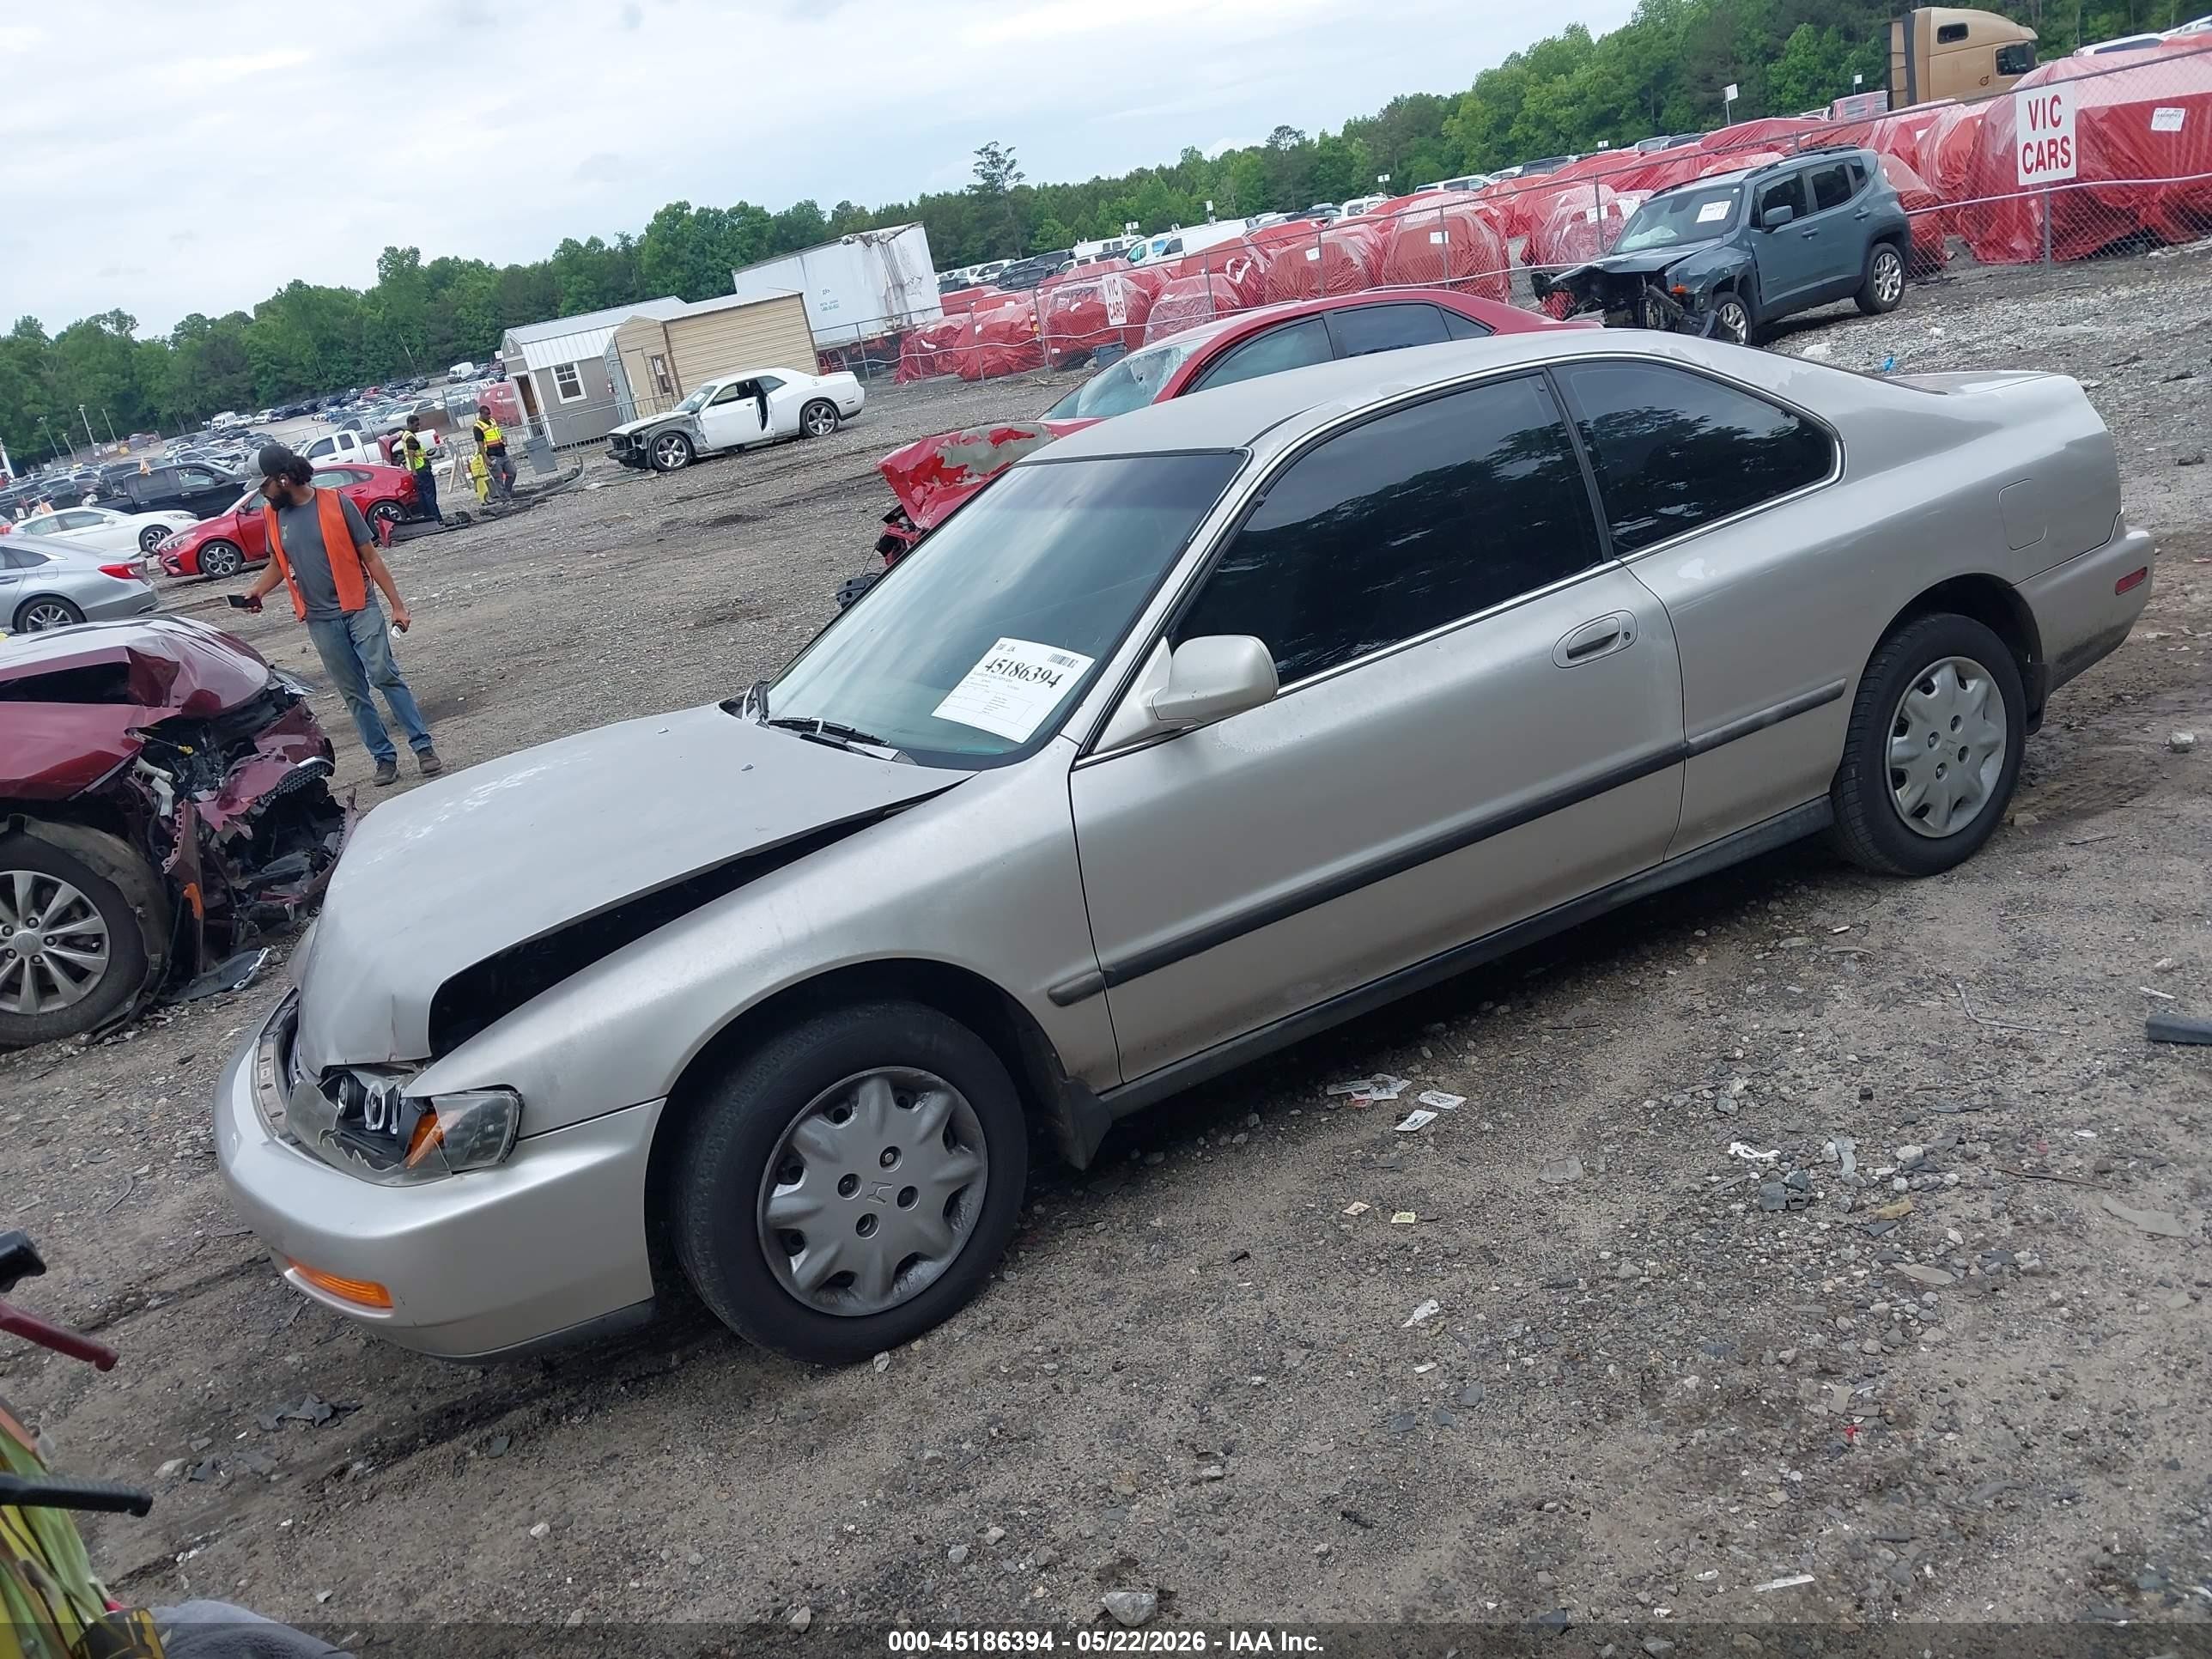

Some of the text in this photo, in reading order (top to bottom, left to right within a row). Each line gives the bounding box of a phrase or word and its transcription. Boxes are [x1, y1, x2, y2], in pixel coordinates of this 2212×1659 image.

[2027, 94, 2063, 131] VIC
[2022, 136, 2071, 174] CARS
[1105, 278, 1119, 296] VIC
[1108, 301, 1125, 319] CARS
[984, 658, 1064, 688] 45186394
